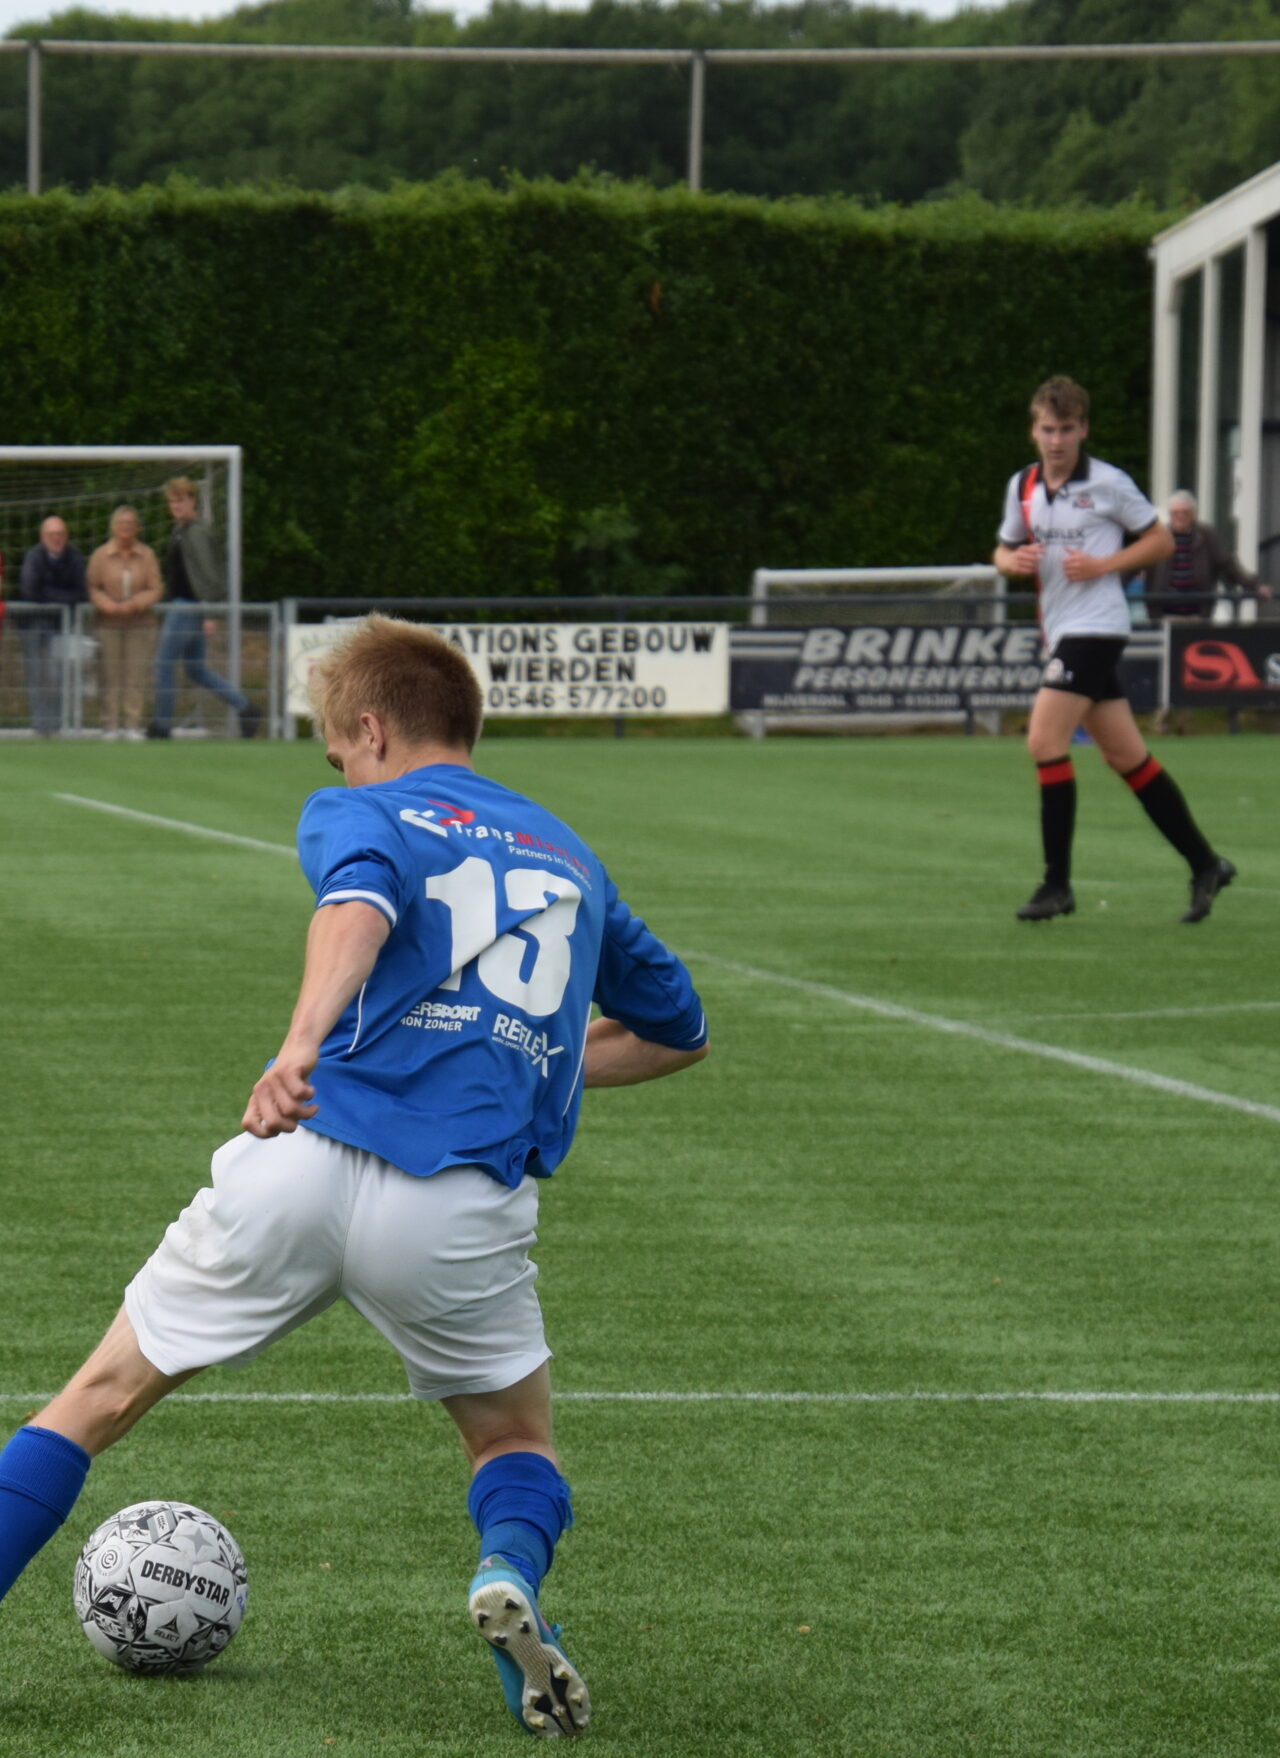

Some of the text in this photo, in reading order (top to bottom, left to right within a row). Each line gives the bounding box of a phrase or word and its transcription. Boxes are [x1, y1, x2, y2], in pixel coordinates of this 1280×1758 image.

[440, 629, 715, 653] ATIONS GEBOUW
[800, 628, 1050, 663] BRINKE
[488, 658, 636, 682] WIERDEN
[792, 666, 1042, 689] PERSONENVERVO
[507, 845, 553, 862] Partners
[425, 855, 582, 1017] 13
[410, 1001, 481, 1021] ERSPORT
[424, 1018, 463, 1032] ZOMER
[493, 1013, 565, 1079] REFLEX
[141, 1560, 231, 1607] DERBYSTAR
[153, 1629, 180, 1643] SELECT
